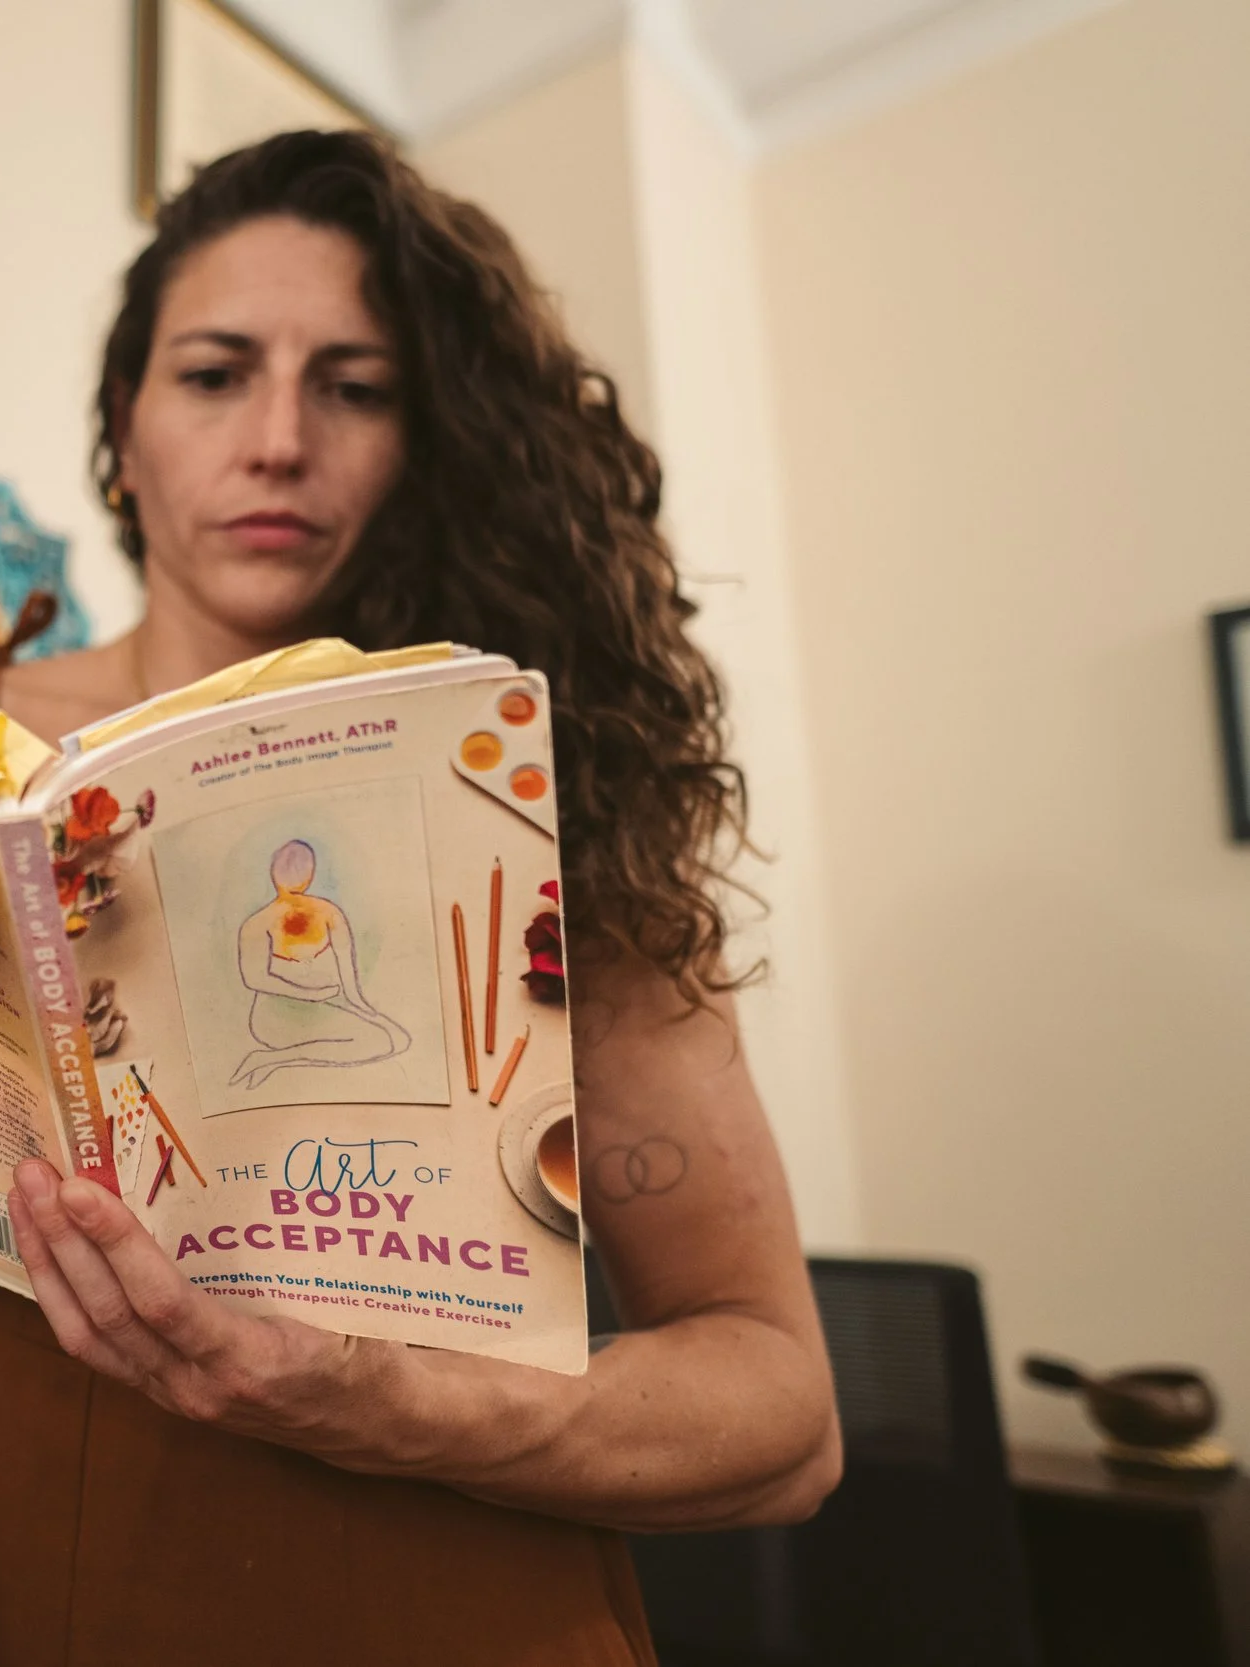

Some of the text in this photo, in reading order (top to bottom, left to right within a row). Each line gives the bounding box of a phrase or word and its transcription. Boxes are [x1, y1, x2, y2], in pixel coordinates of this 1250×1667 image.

[191, 719, 398, 775] Ashlee Bennett, AThR
[199, 740, 393, 788] Creator of The Body Image Therapist
[10, 838, 103, 1170] The Art of BODY ACCEPTANCE
[216, 1163, 269, 1183] THE
[414, 1166, 452, 1184] OF
[269, 1188, 415, 1223] BODY
[175, 1223, 530, 1278] ACCEPTANCE
[203, 1286, 512, 1330] Through Therapeutic Creative Exercises
[276, 1273, 311, 1288] Your
[314, 1277, 413, 1300] Relationship
[416, 1286, 452, 1304] with
[455, 1294, 525, 1316] Yourself
